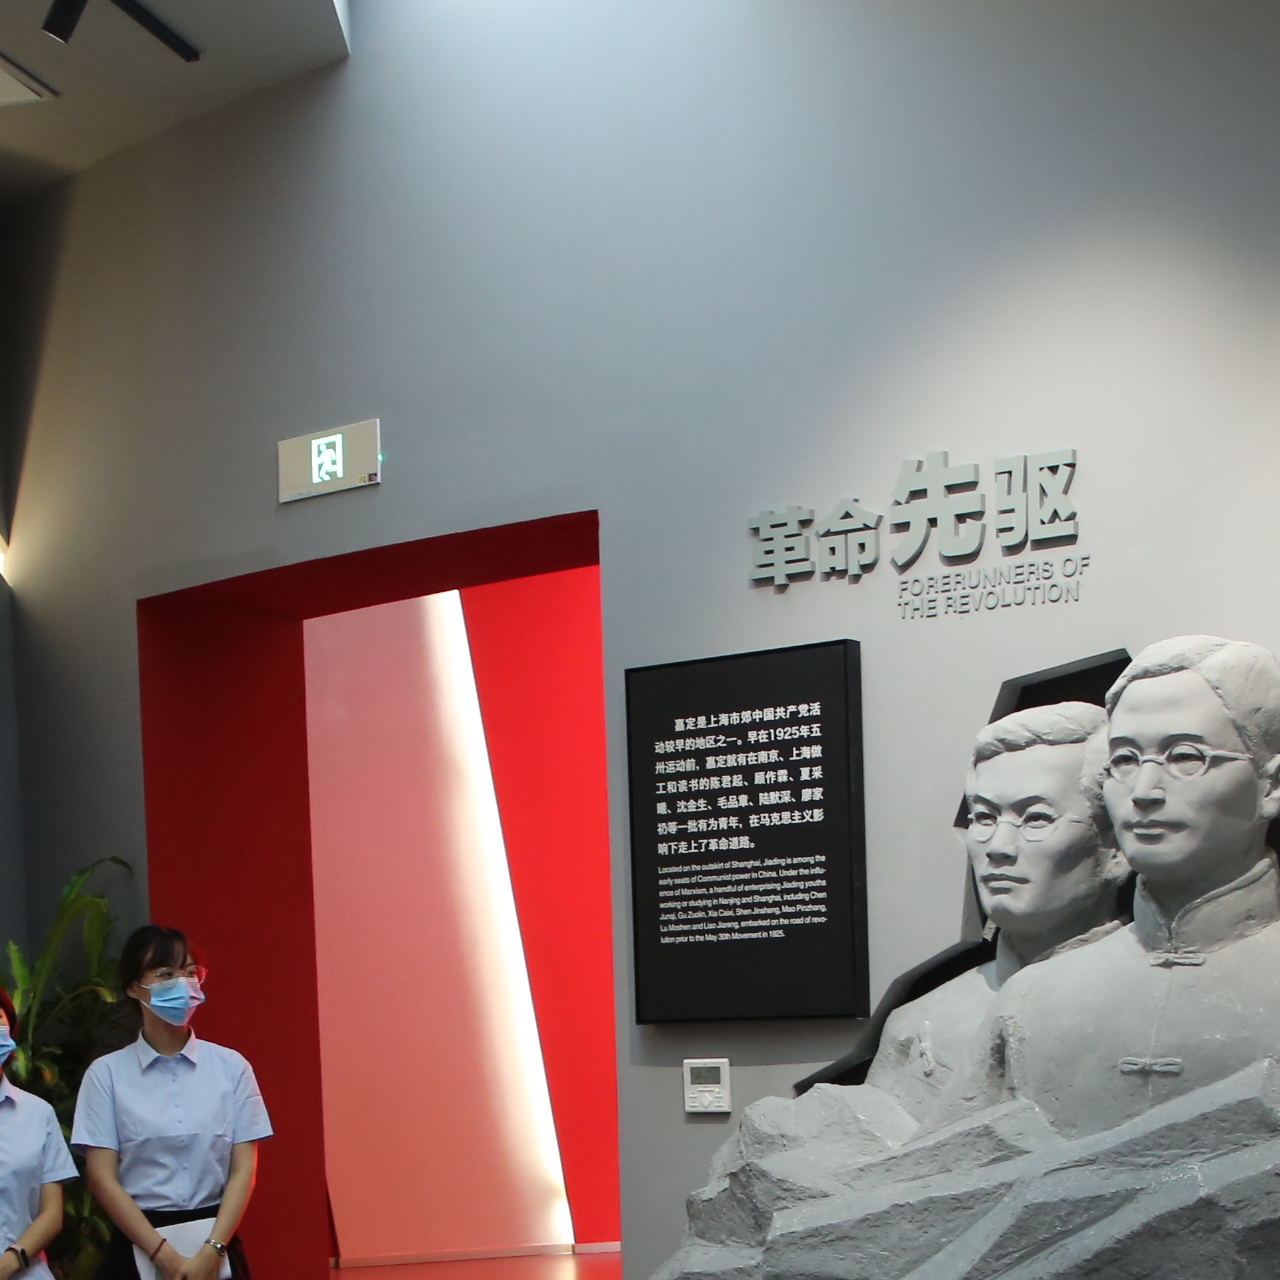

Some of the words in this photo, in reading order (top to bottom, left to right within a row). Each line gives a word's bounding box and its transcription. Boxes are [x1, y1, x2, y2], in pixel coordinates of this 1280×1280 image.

[748, 448, 1079, 594] 革命先驱
[899, 560, 1054, 599] FORERUNNERS
[1062, 555, 1091, 577] OF
[897, 597, 937, 620] THE
[944, 580, 1081, 615] REVOLUTION
[674, 702, 822, 732] 嘉定是上海市郊中国共产党活
[654, 723, 822, 754] 动较早的地区之一。早在1925年五
[655, 745, 823, 774] 卅运动前，嘉定就有在南京、上海做
[656, 766, 823, 794] 工和读书的陈君起、顾作霖、夏采
[657, 836, 756, 855] 响下走上了革命道路。
[658, 865, 682, 874] Located
[792, 856, 814, 865] among
[697, 873, 732, 883] Communist
[731, 873, 751, 881] power
[779, 868, 798, 877] Under
